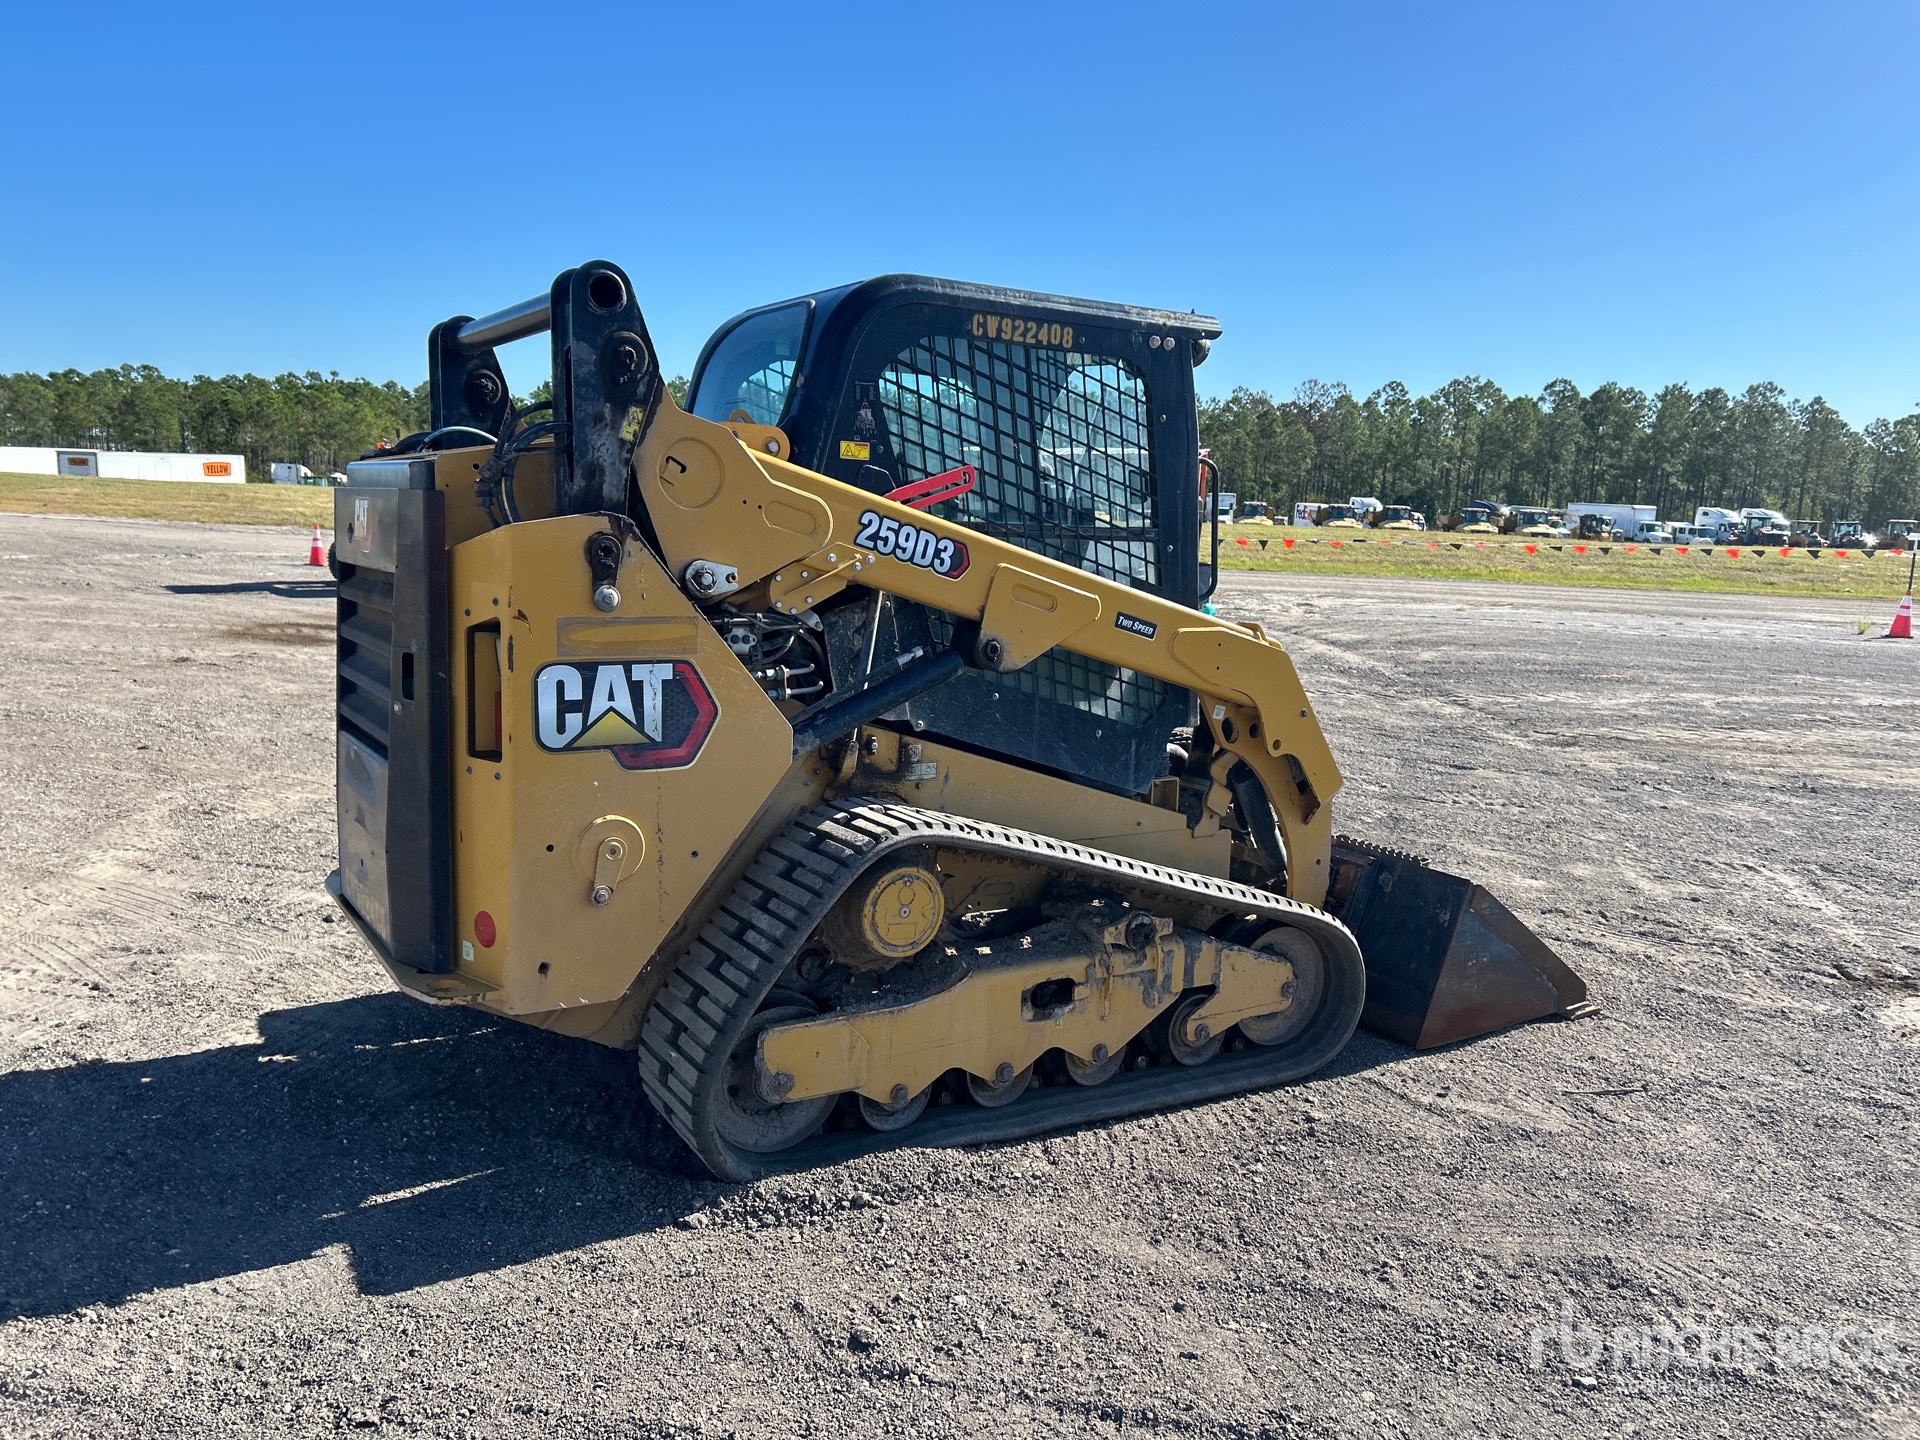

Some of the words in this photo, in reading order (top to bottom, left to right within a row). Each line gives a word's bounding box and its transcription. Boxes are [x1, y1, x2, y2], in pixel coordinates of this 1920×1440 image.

[972, 314, 1074, 349] CW922408
[206, 464, 229, 474] YELLOW
[353, 498, 369, 537] CAT
[855, 511, 955, 573] 259D3
[536, 663, 674, 749] CAT
